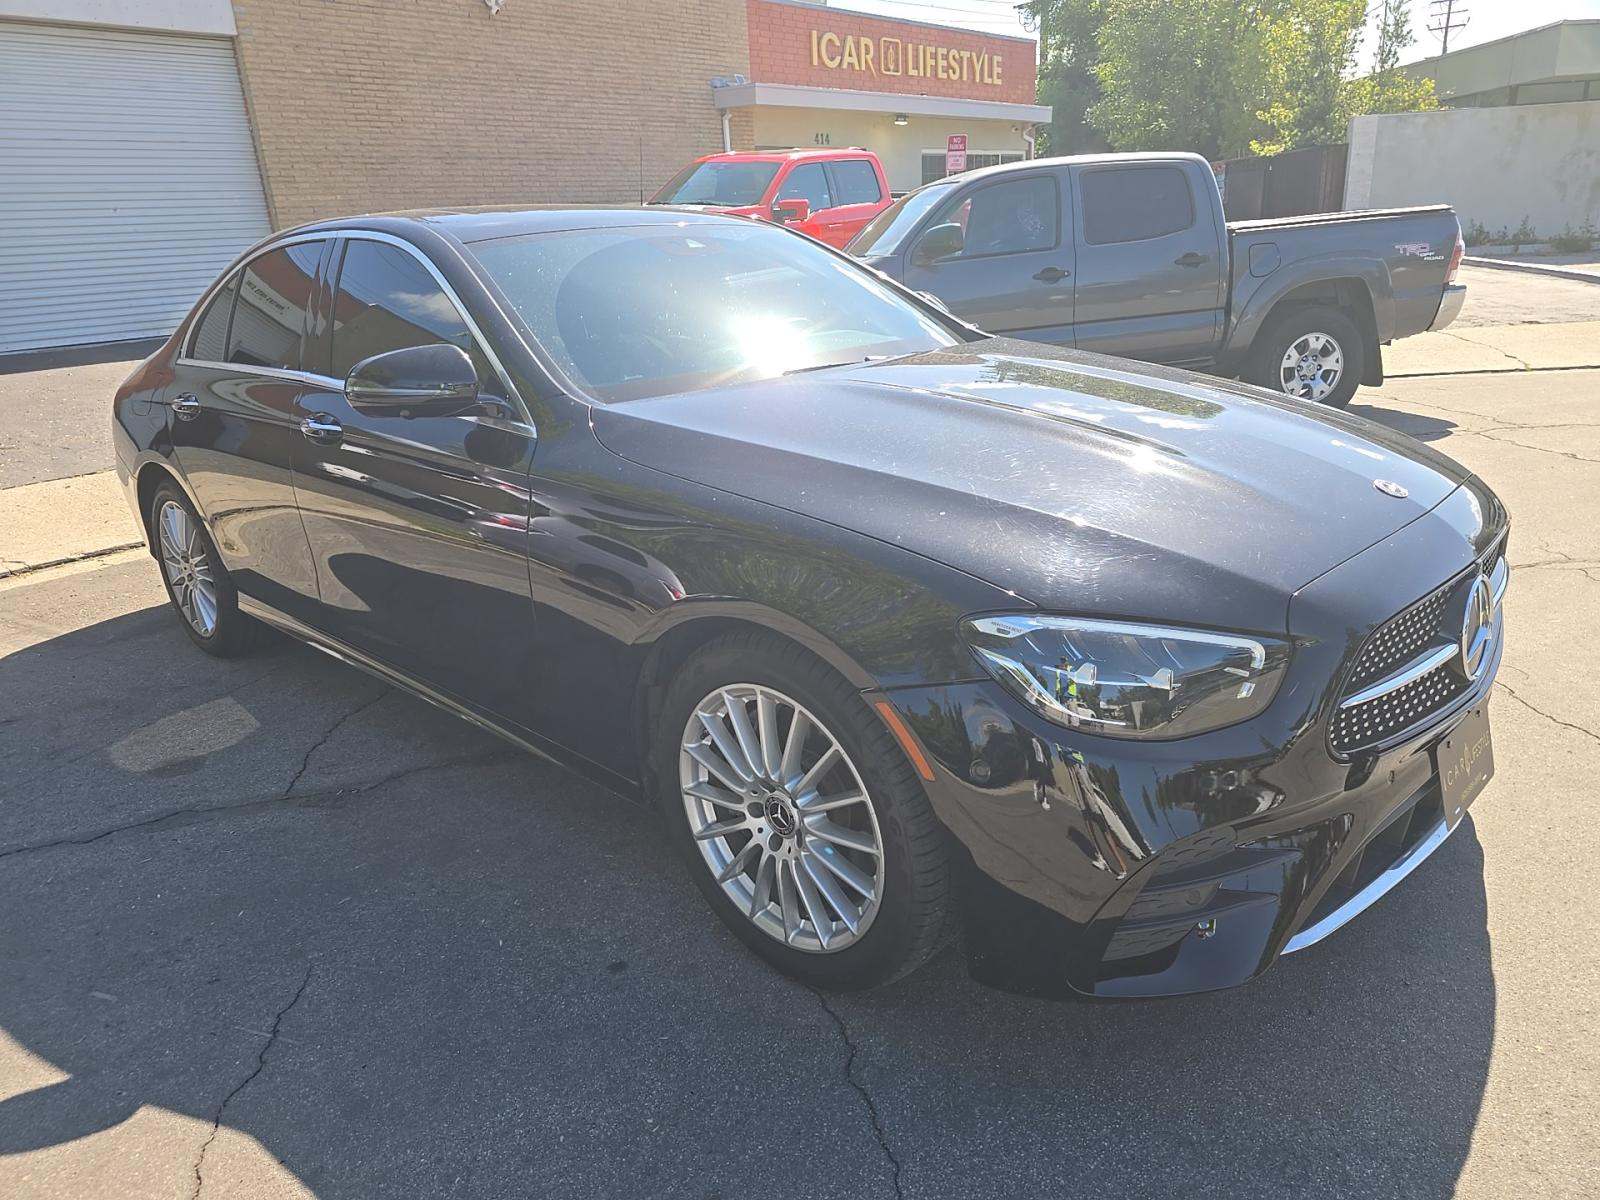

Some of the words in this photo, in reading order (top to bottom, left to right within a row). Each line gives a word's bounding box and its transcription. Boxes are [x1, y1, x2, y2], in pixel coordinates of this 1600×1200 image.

[811, 30, 877, 77] ICAR
[907, 43, 1002, 85] LIFESTYLE
[814, 132, 831, 145] 414
[1395, 243, 1430, 256] TRD
